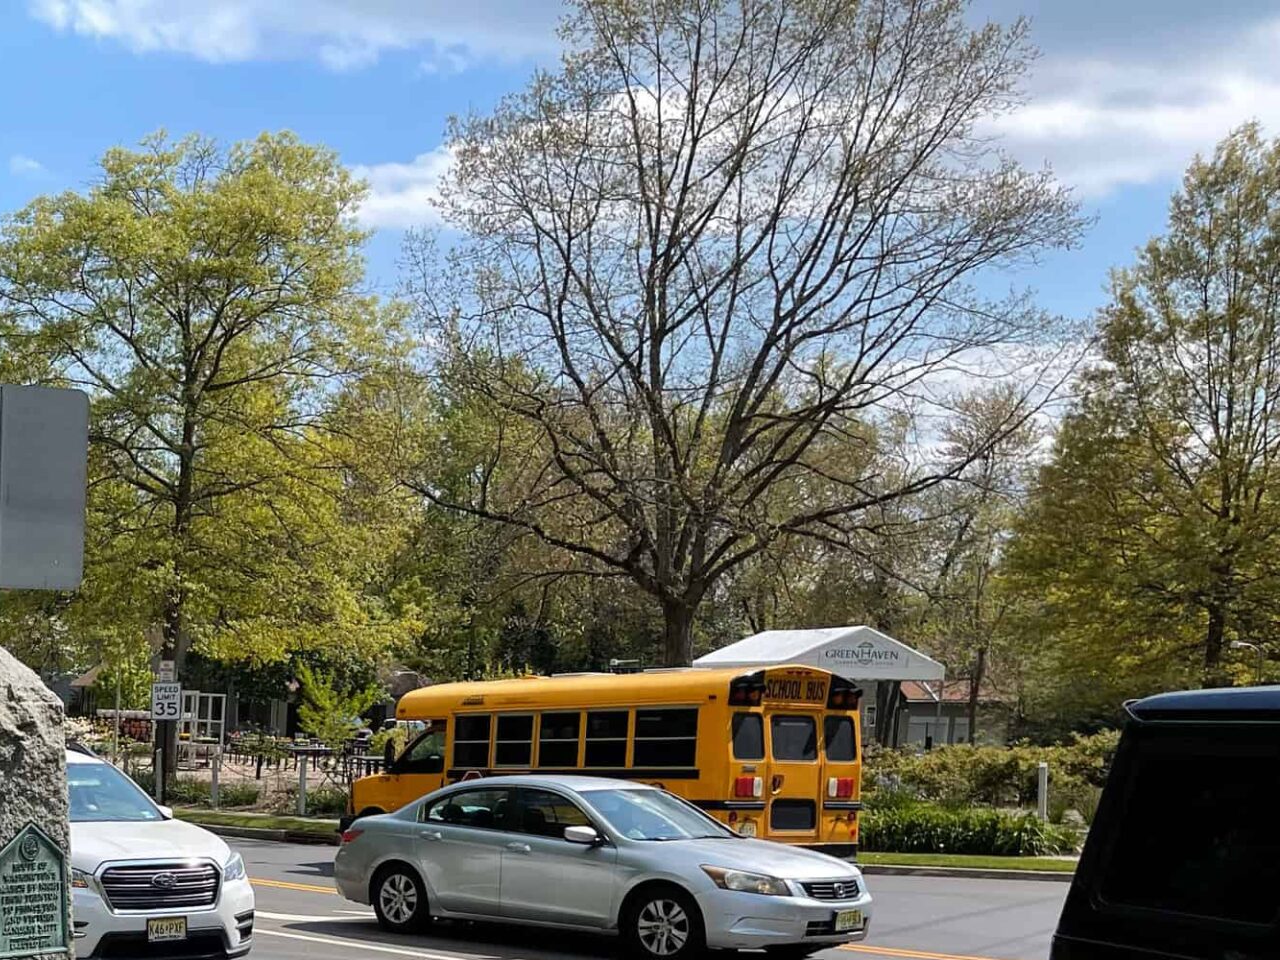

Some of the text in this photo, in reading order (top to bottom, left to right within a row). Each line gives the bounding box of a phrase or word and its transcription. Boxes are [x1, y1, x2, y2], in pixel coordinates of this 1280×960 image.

[766, 679, 826, 700] SCHOOL BUS
[155, 702, 177, 716] 35
